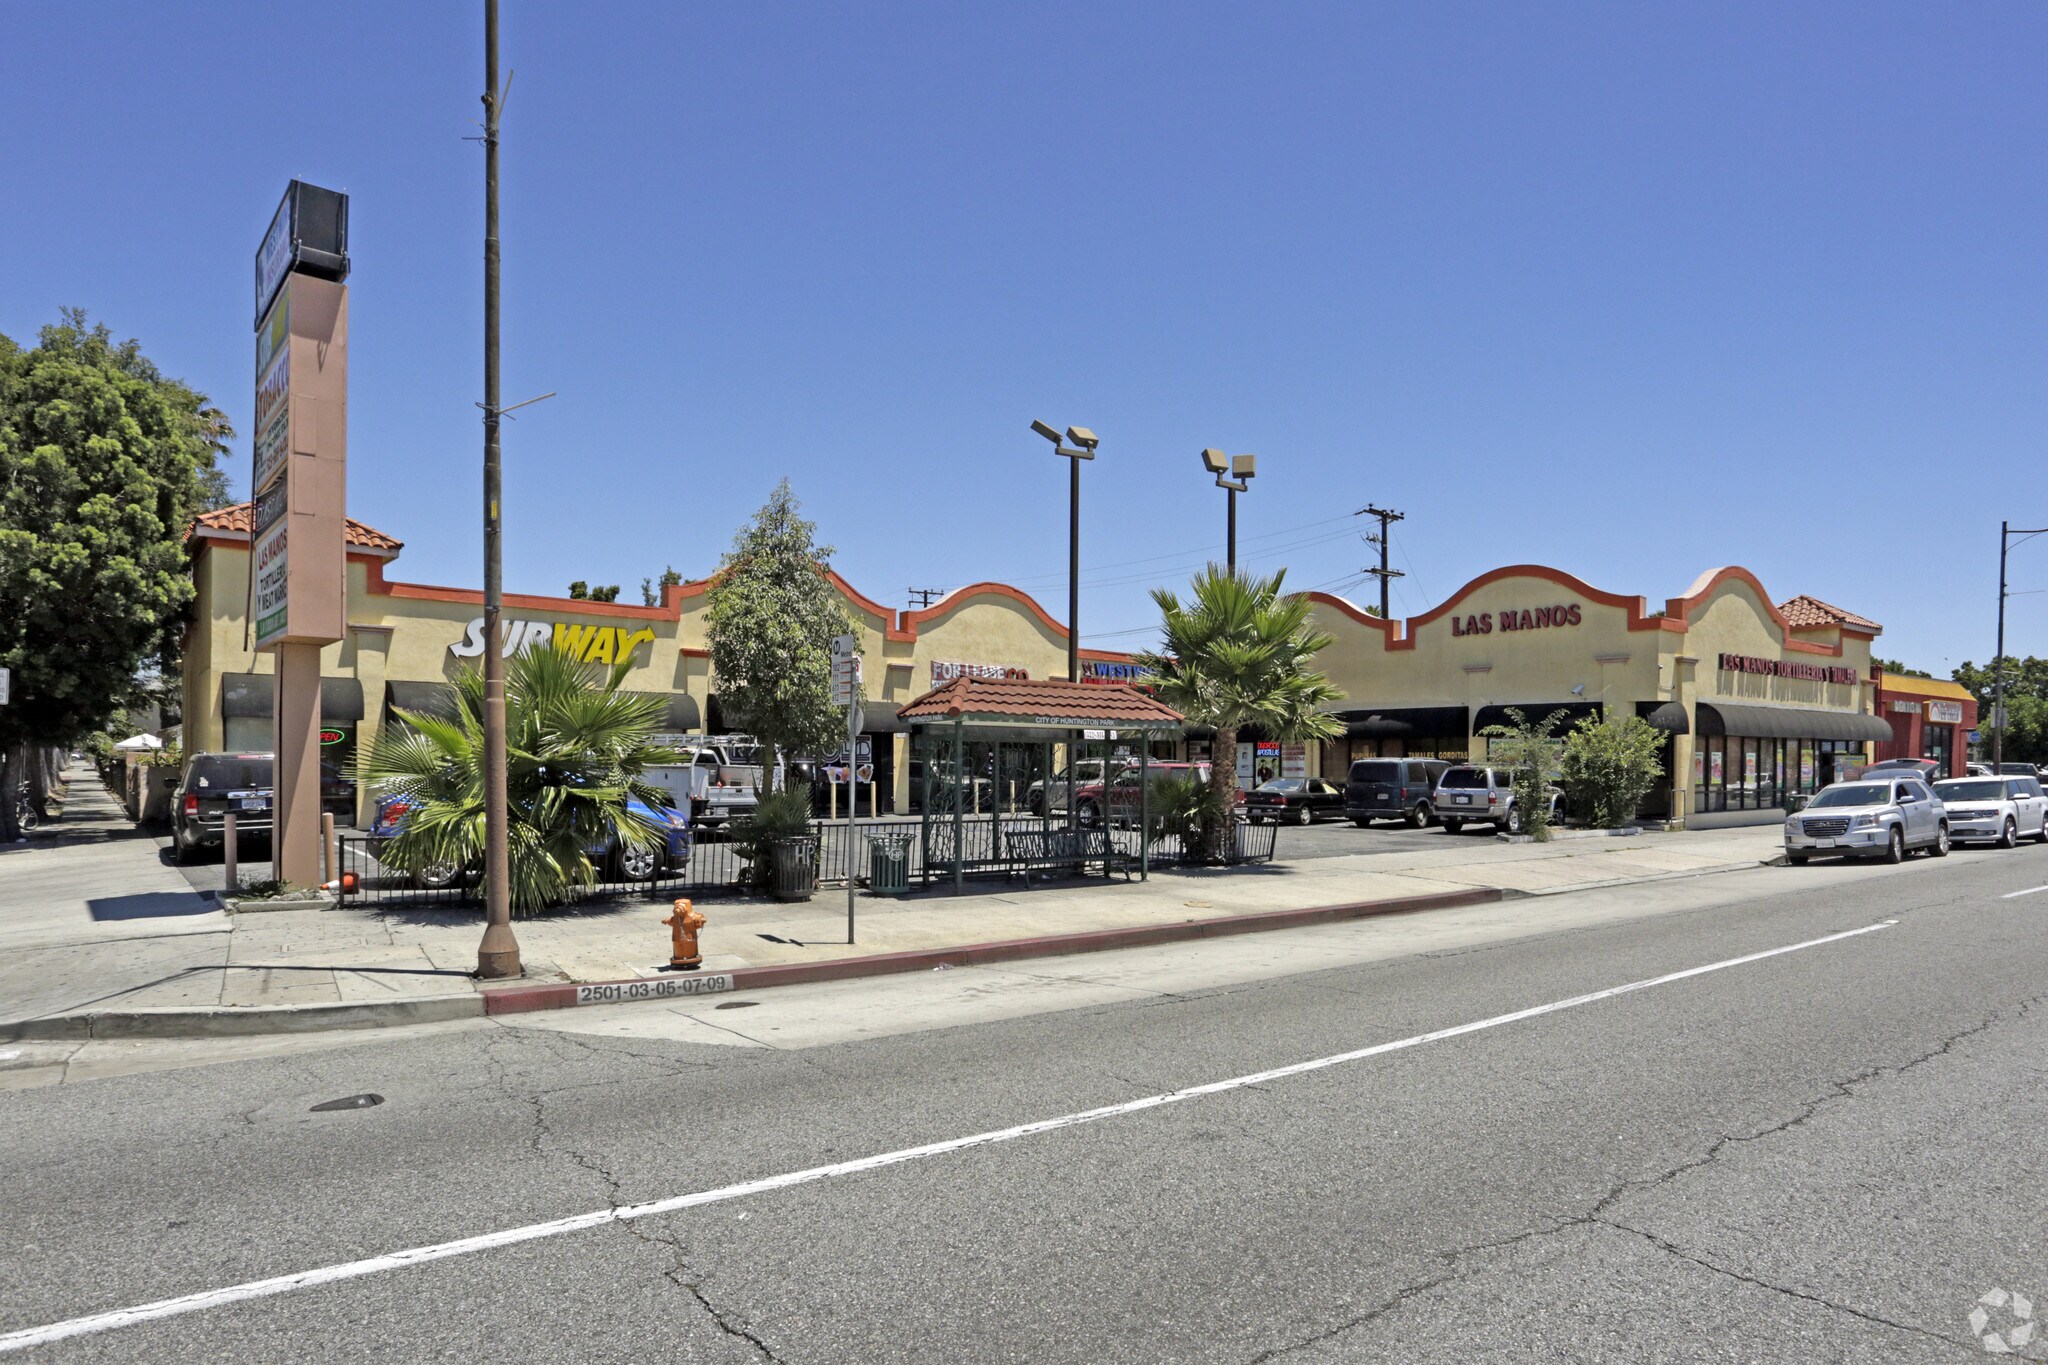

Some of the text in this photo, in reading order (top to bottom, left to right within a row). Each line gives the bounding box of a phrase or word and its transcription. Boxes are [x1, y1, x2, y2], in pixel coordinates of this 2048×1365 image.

[258, 527, 288, 571] LAS MANOS
[1452, 603, 1582, 637] LAS MANOS
[448, 617, 656, 664] SUBWAY
[933, 662, 961, 679] FOR
[1720, 653, 1740, 671] LAS
[1741, 656, 1773, 676] MANOS
[1775, 661, 1824, 681] TORTILLERIA
[1035, 716, 1049, 724] CITY
[1060, 717, 1099, 726] HUNTINGTON
[320, 733, 339, 741] PEN
[1351, 752, 1376, 760] PUPUSAS
[1437, 752, 1468, 760] GORDITAS
[796, 844, 815, 866] HP
[581, 976, 726, 1001] 2501-03-05-07-09
